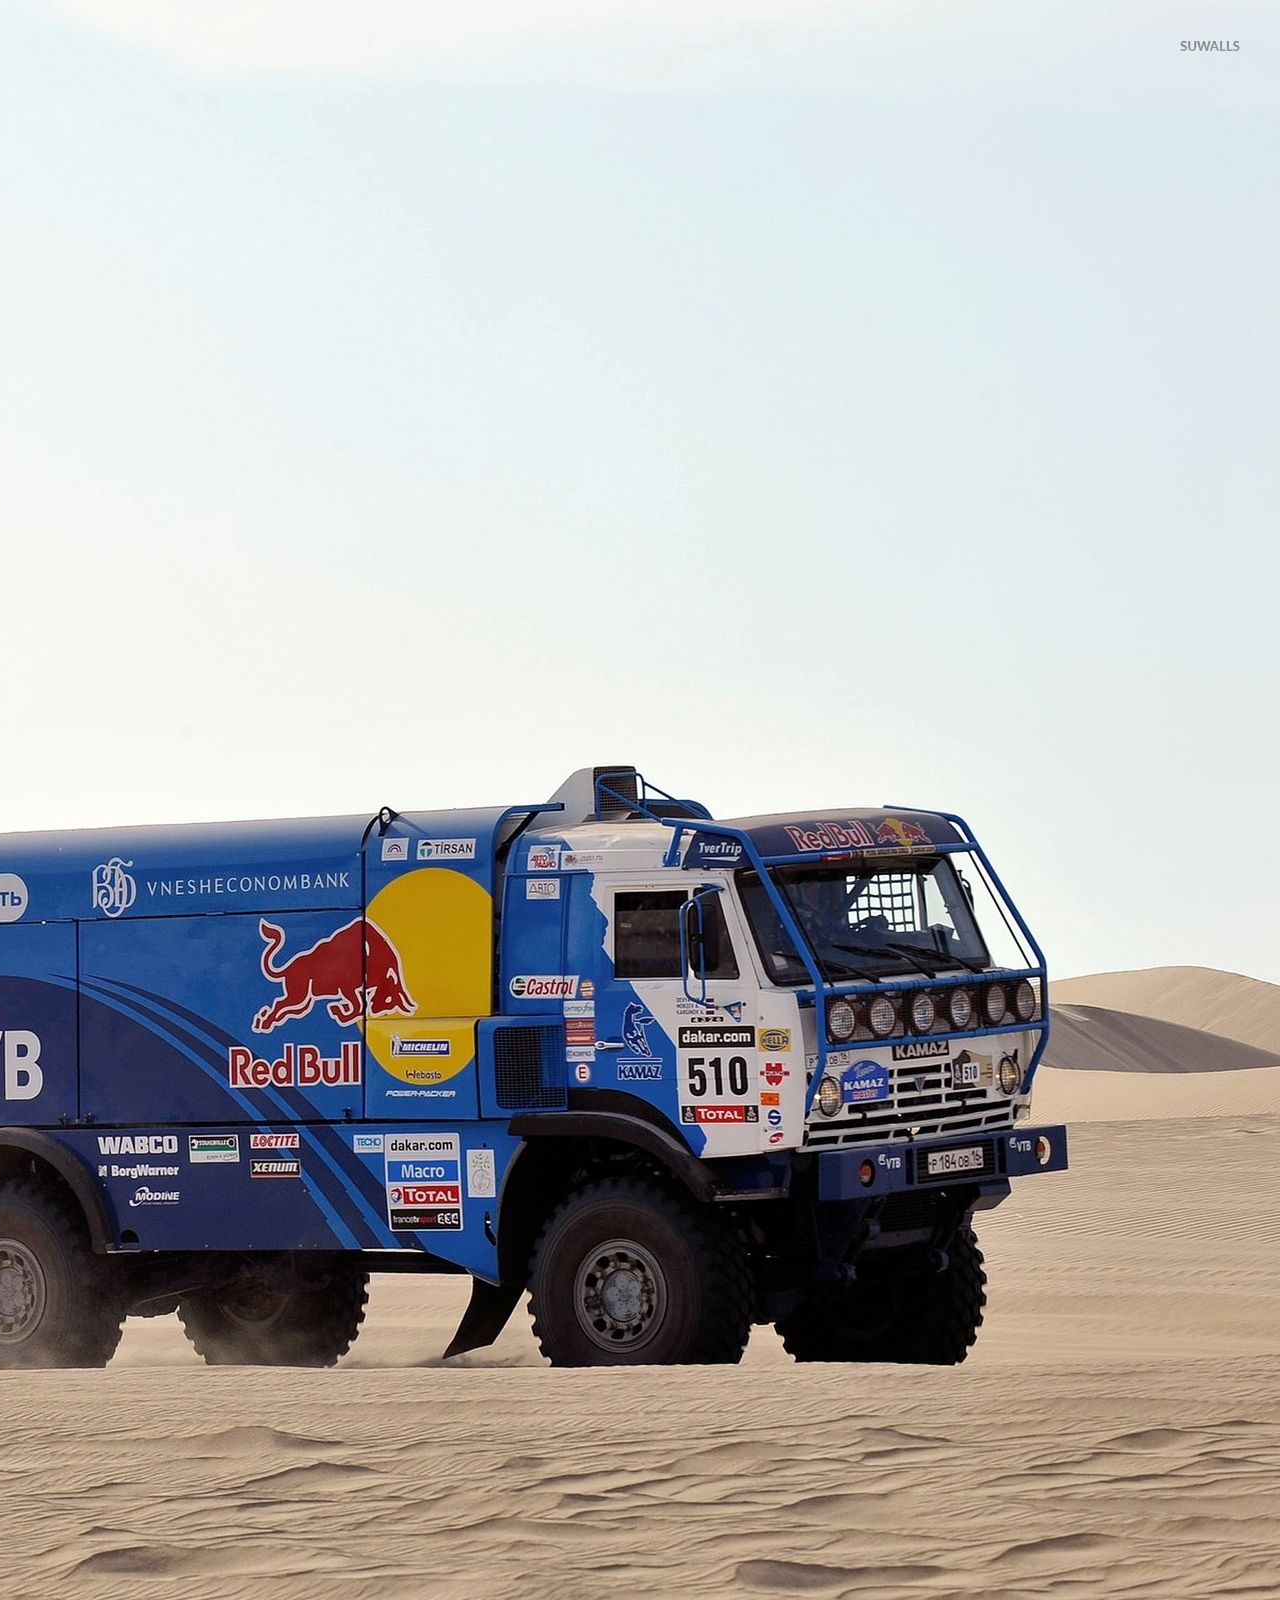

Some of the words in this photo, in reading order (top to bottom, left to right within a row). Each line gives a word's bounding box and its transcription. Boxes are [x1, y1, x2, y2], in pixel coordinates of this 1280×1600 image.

[784, 824, 830, 851] Red
[827, 820, 874, 848] Bull
[698, 842, 742, 854] TverTrip
[147, 872, 349, 896] VNESHECONOMBANK
[526, 979, 574, 995] Castrol
[682, 1030, 751, 1043] dakar.com
[402, 1043, 448, 1051] MICHELIN
[895, 1042, 947, 1058] KAMAZ
[230, 1043, 294, 1087] Red
[298, 1041, 361, 1086] Bull
[618, 1065, 663, 1080] KAMAZ
[688, 1056, 748, 1097] 510
[964, 1065, 978, 1080] 510
[844, 1077, 884, 1091] KAMAZ
[97, 1136, 178, 1154] WABCO
[252, 1135, 297, 1147] LOCTITE
[390, 1139, 453, 1151] dakar.com
[1017, 1141, 1031, 1152] VTB
[885, 1157, 901, 1168] VTB
[941, 1153, 956, 1168] 184
[111, 1164, 179, 1179] BorgWarner
[401, 1164, 445, 1178] Macro
